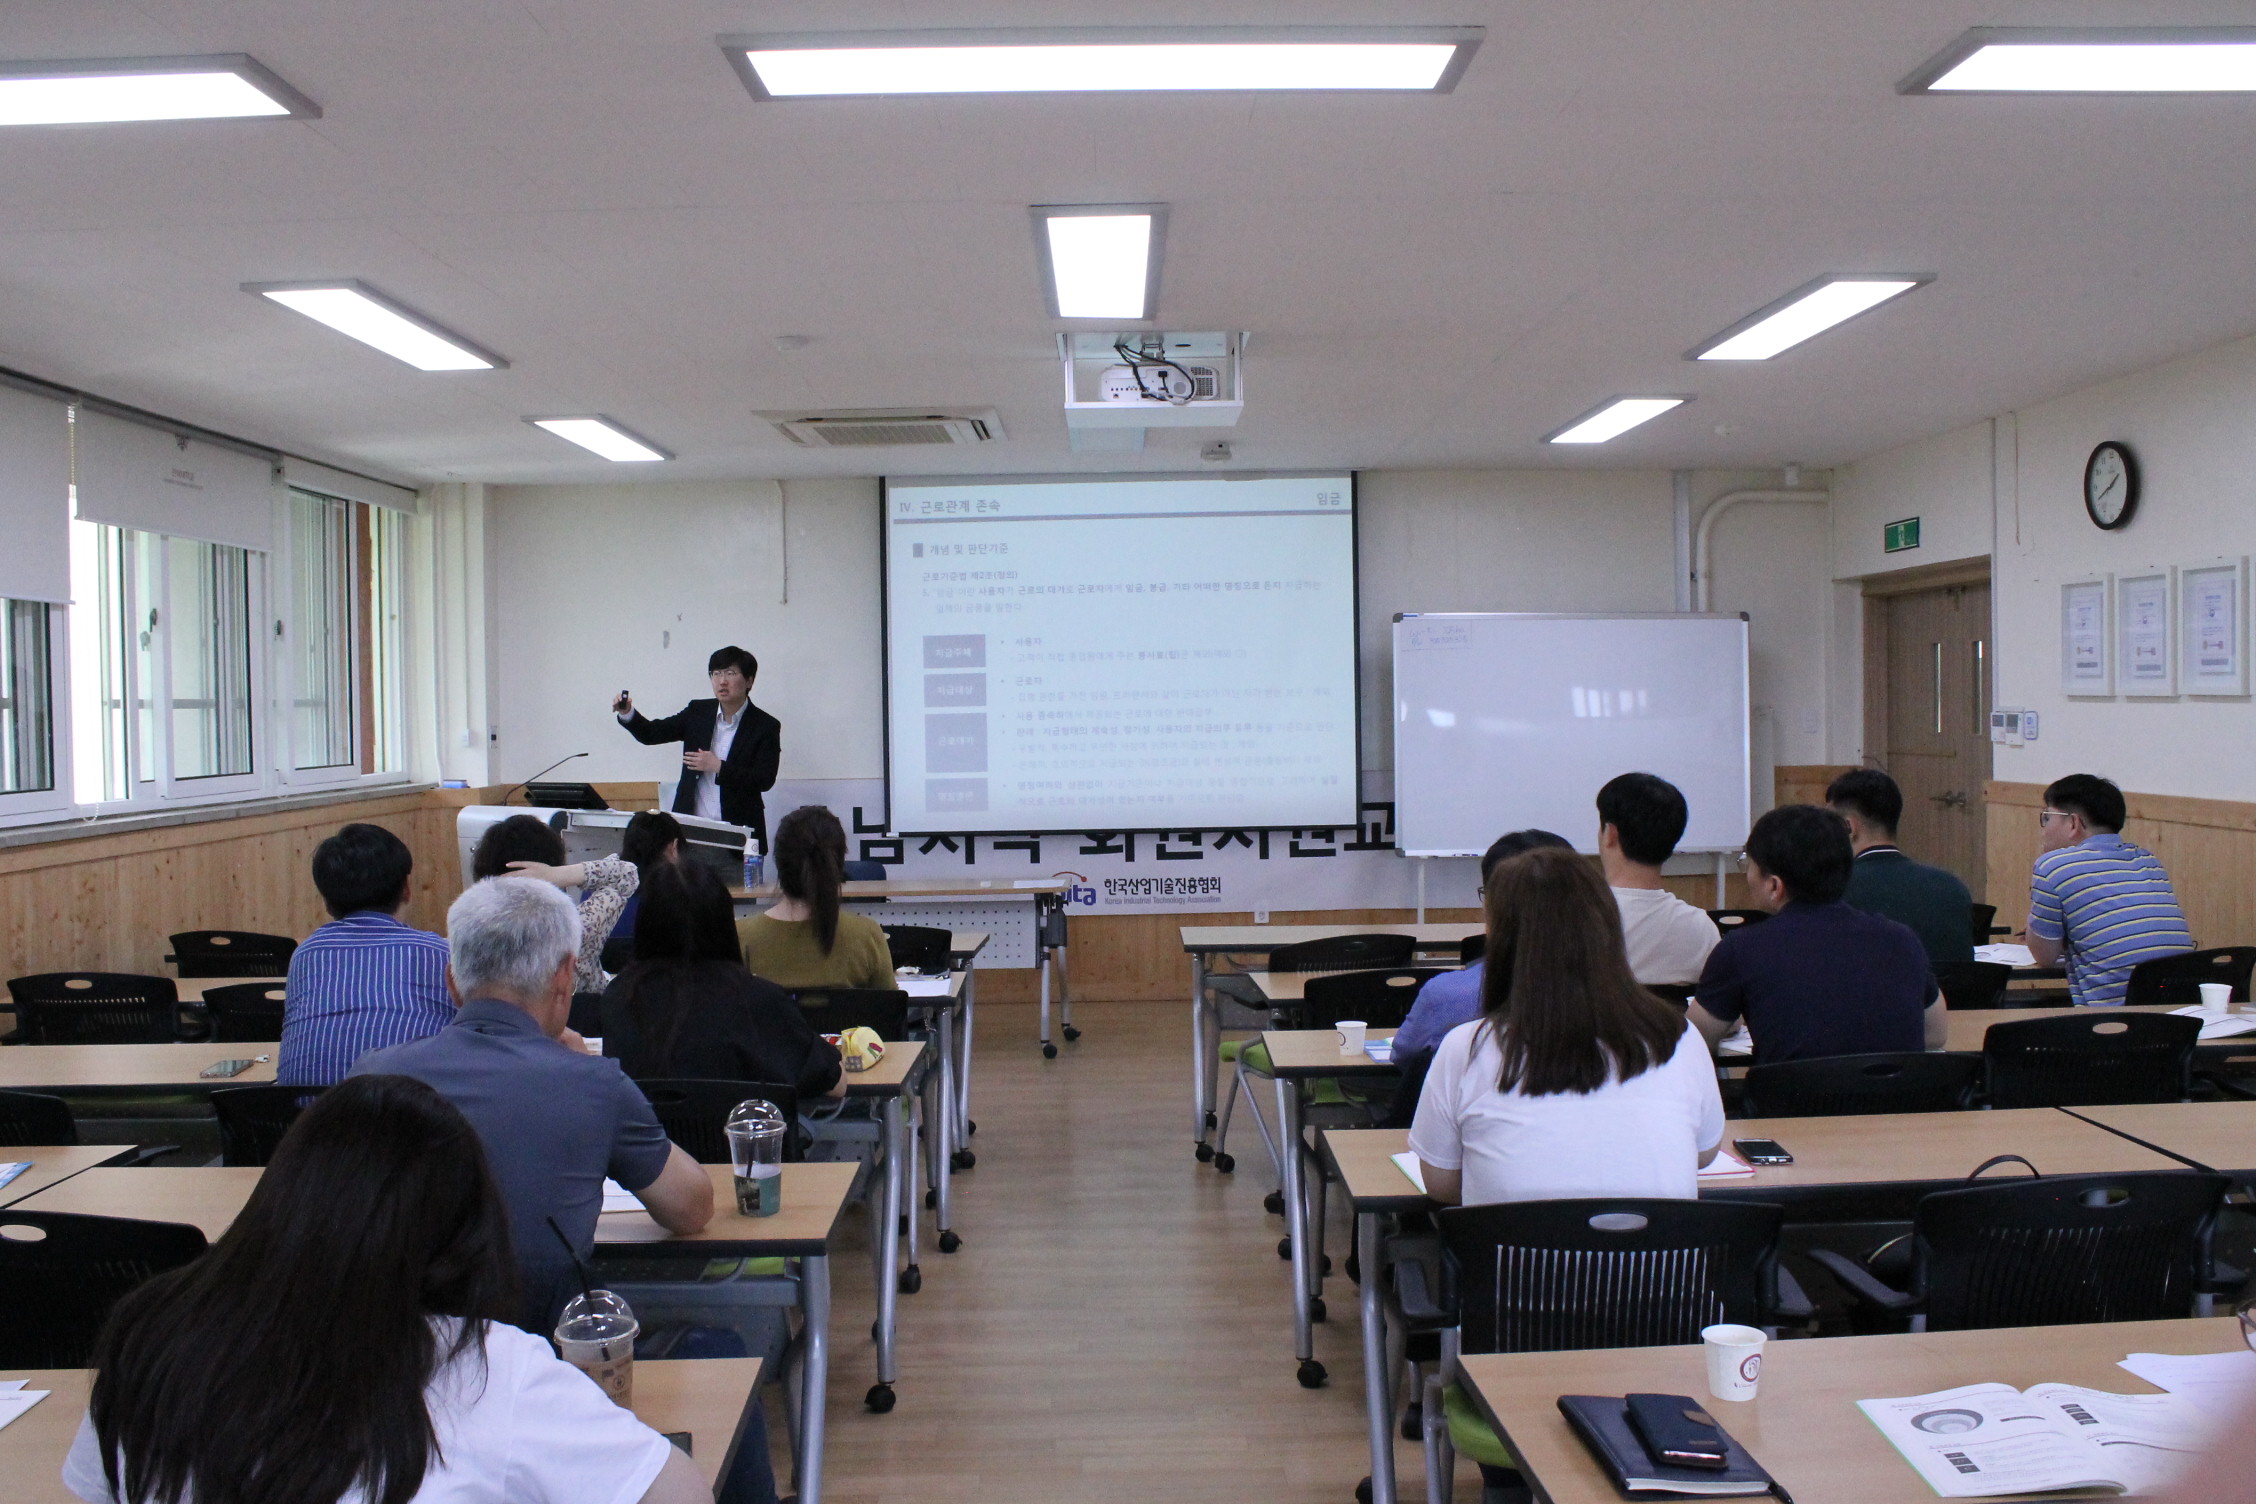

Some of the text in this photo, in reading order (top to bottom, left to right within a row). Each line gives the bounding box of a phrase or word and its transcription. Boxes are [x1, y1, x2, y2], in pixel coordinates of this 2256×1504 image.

[1316, 492, 1341, 506] 임금
[920, 500, 971, 514] 근로관계
[976, 499, 1001, 512] 존속
[929, 542, 1009, 556] 개념 및 판단기준
[922, 571, 967, 582] 근로기준법
[1104, 876, 1221, 895] 한국산업기술진흥협회
[1153, 896, 1186, 905] Technology
[1188, 896, 1221, 904] Association
